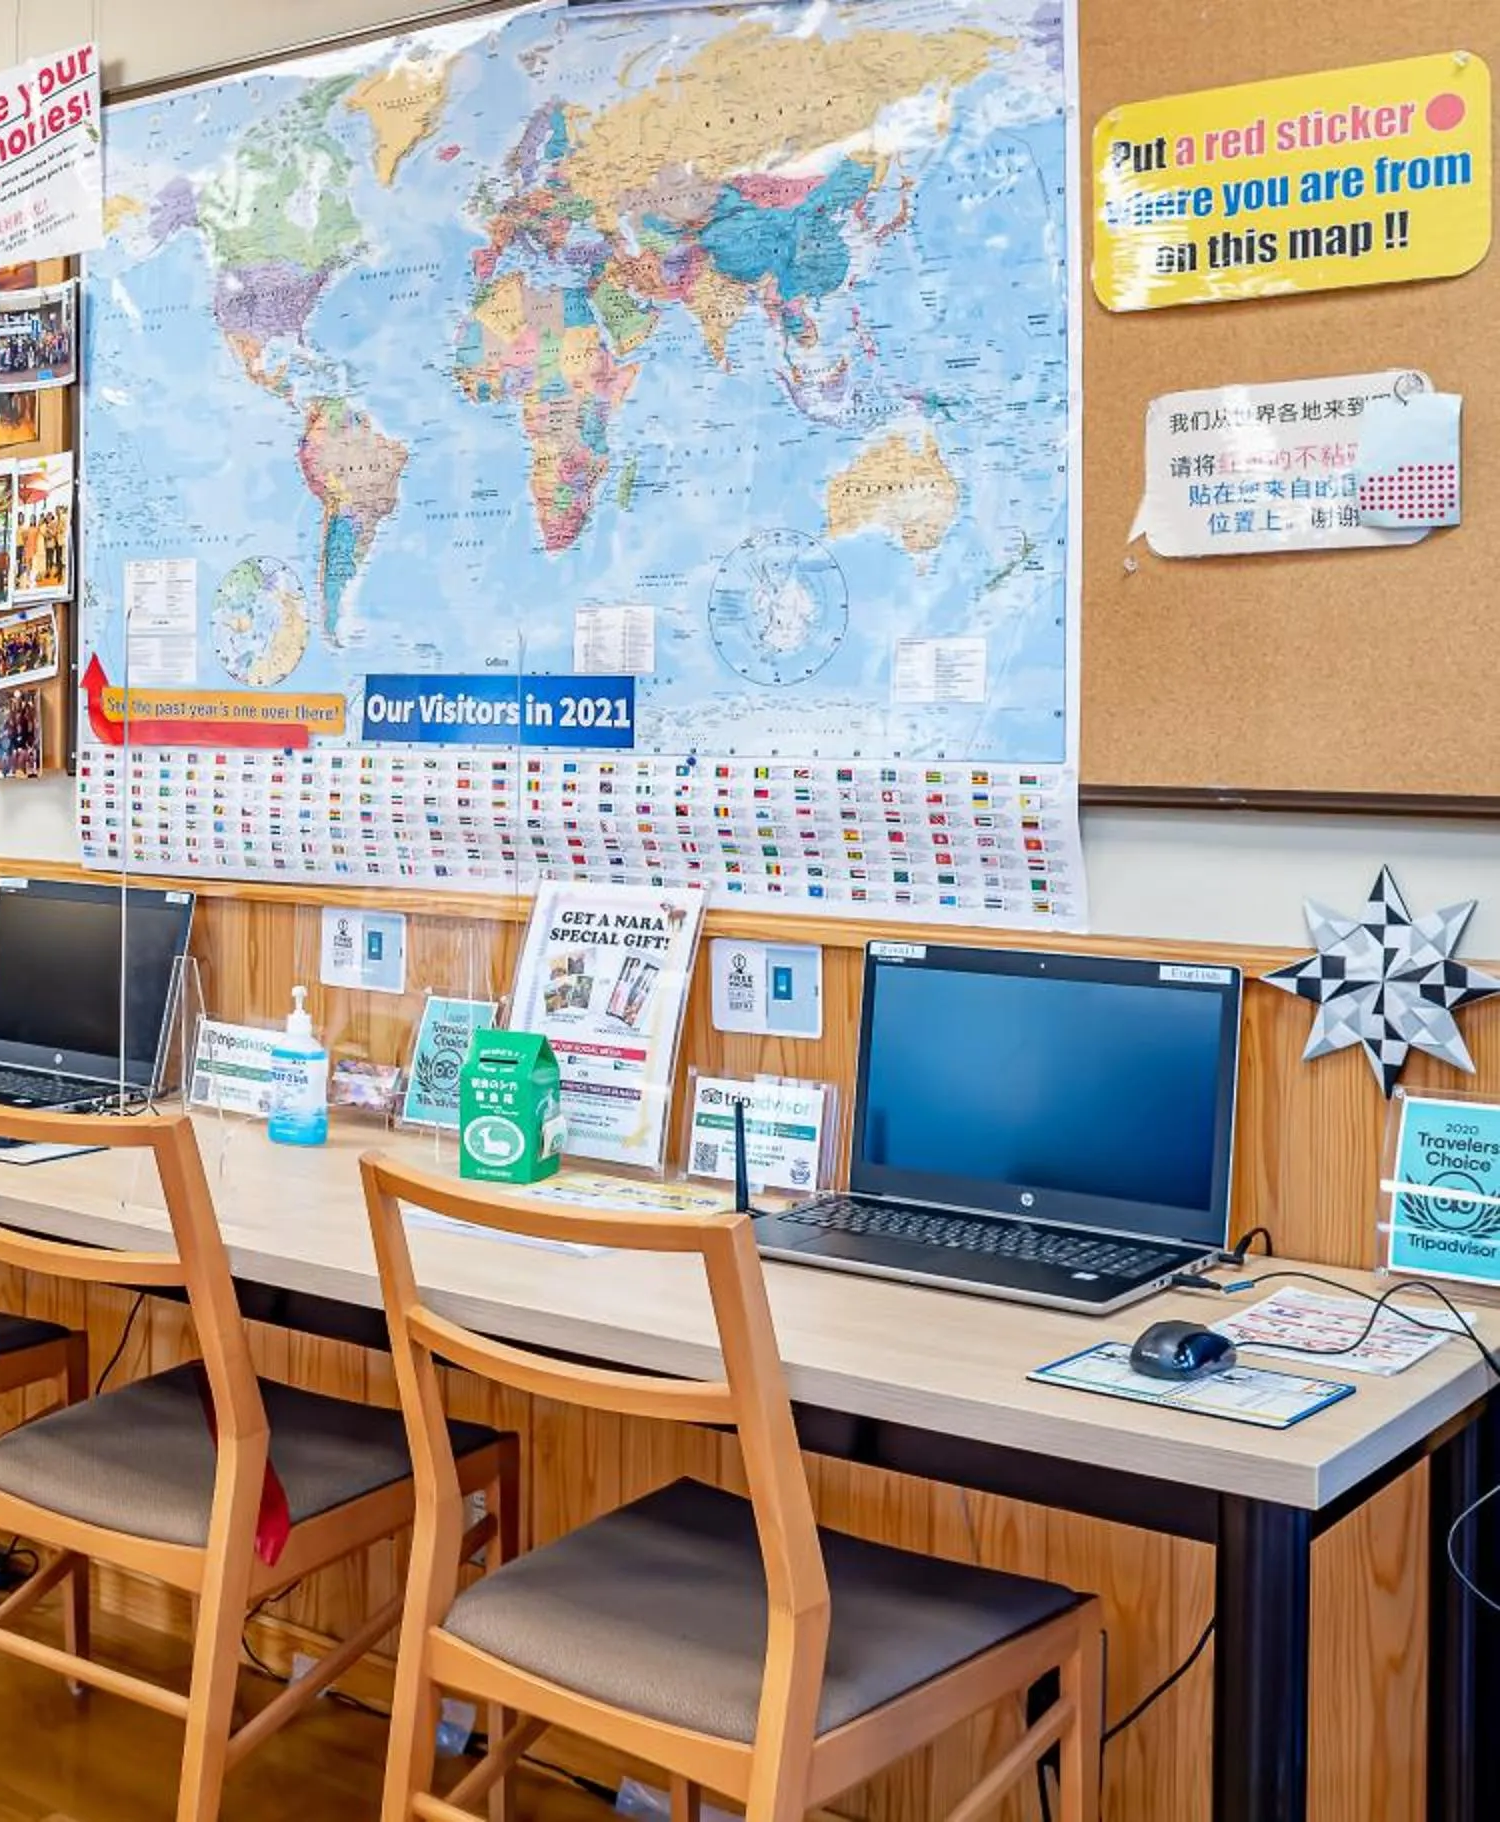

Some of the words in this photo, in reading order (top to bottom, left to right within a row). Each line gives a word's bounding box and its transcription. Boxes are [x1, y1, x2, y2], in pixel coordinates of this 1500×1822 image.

[18, 46, 92, 119] your
[1111, 136, 1167, 173] Put
[1176, 135, 1194, 166] a
[1204, 119, 1265, 161] red
[1276, 101, 1415, 151] sticker
[1222, 176, 1289, 217] you
[1300, 162, 1365, 204] are
[1375, 151, 1472, 194] from
[1155, 241, 1197, 274] on
[1208, 228, 1277, 269] this
[1289, 220, 1372, 260] map
[1385, 211, 1410, 249] !!
[156, 702, 185, 717] past
[233, 705, 257, 719] one
[261, 705, 291, 720] over
[367, 694, 414, 724] Our
[419, 693, 520, 726] Visitors
[526, 694, 552, 725] in
[559, 697, 631, 728] 2021
[562, 911, 596, 926] GET
[598, 914, 610, 927] A
[614, 915, 665, 931] NARA
[549, 928, 619, 946] SPECIAL
[623, 934, 672, 951] GIFT!
[1445, 1123, 1479, 1137] 2020
[1425, 1151, 1492, 1174] Choice
[1408, 1232, 1498, 1259] Tripadvisor
